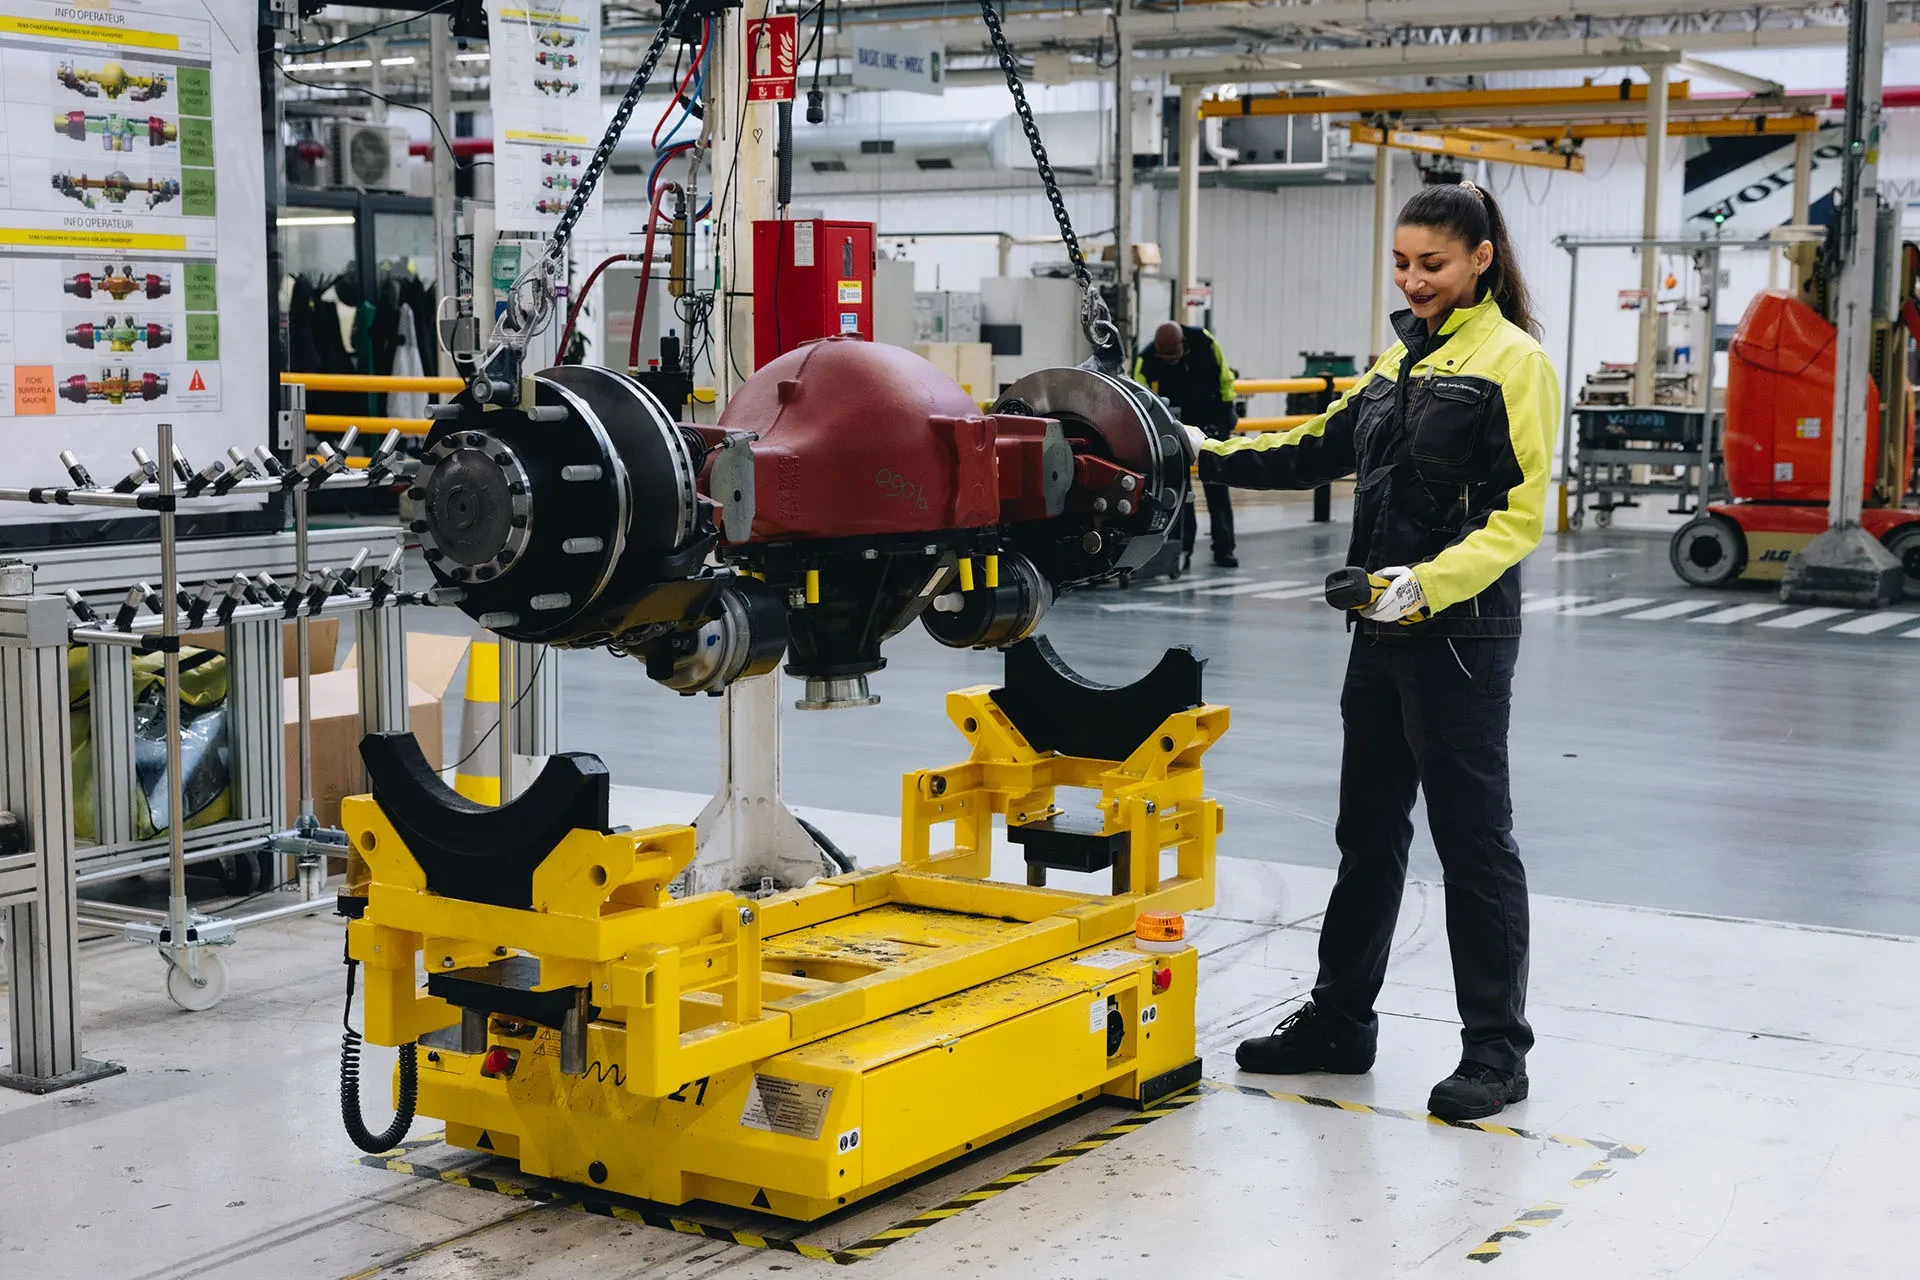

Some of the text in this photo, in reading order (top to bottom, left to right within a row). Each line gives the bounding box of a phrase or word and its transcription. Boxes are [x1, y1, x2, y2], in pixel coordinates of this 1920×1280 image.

[55, 8, 125, 24] INFO OPERATEUR
[881, 52, 897, 70] LINE
[1687, 145, 1846, 222] VOLO
[64, 217, 133, 229] INFO OPERATEUR
[1759, 549, 1792, 561] JLG
[817, 1088, 828, 1099] CE
